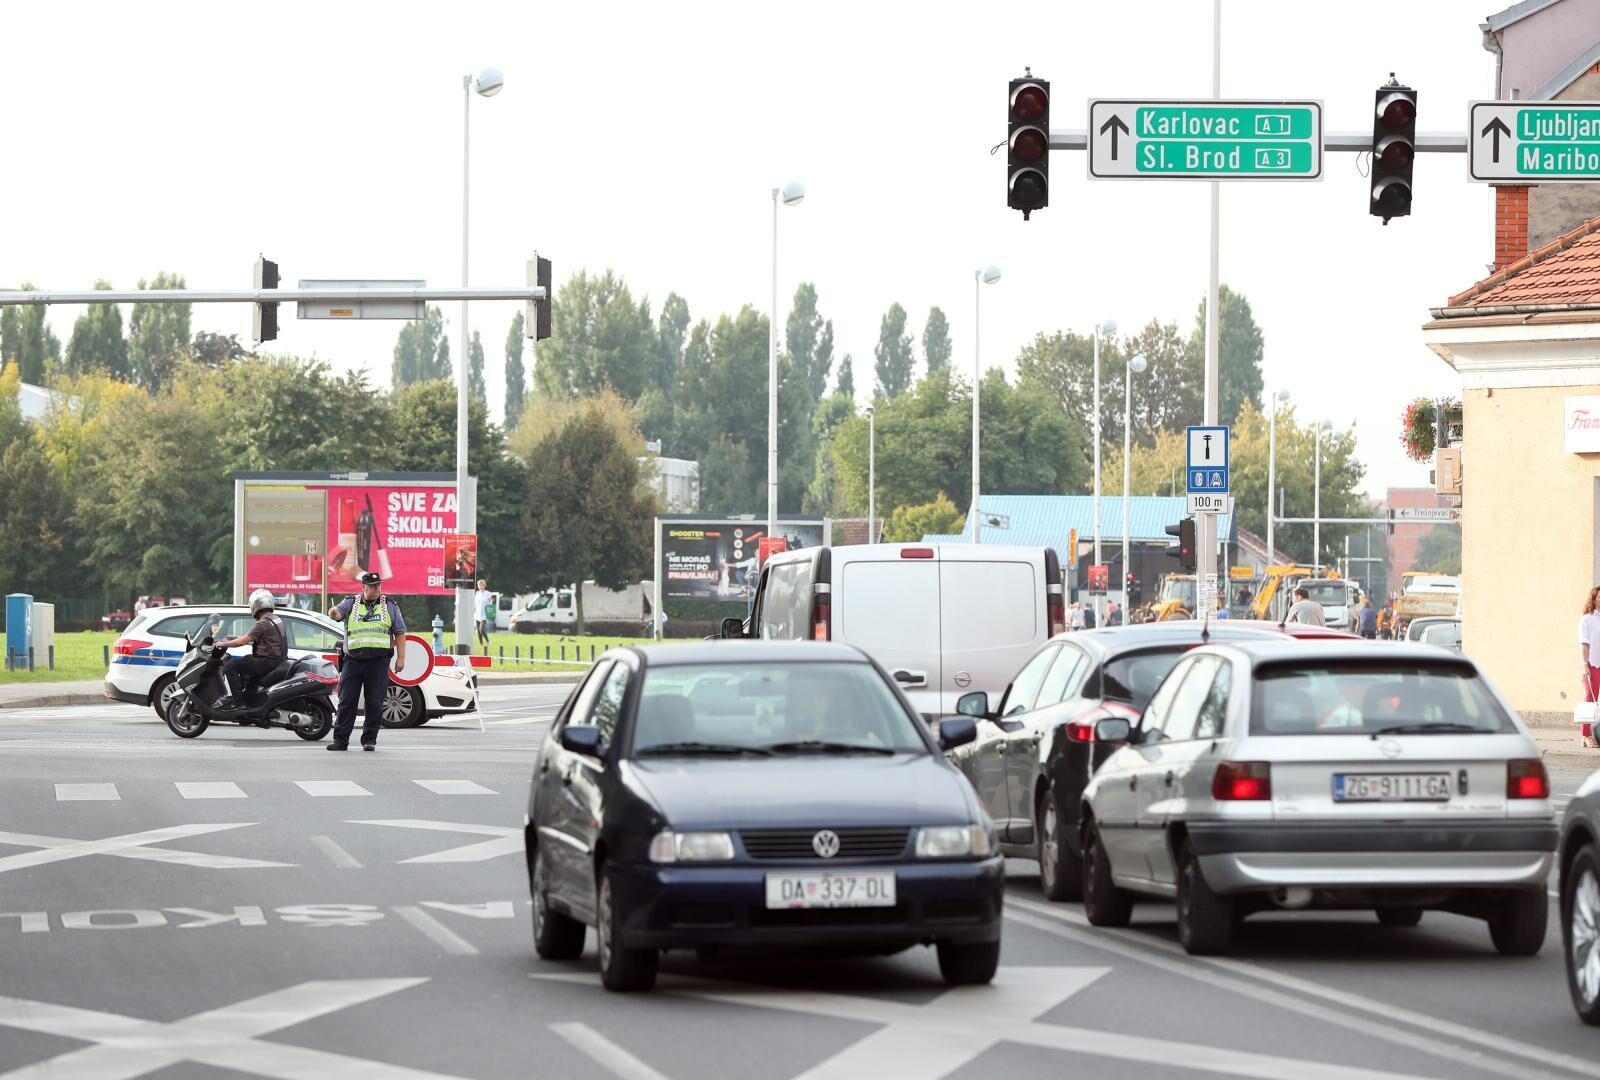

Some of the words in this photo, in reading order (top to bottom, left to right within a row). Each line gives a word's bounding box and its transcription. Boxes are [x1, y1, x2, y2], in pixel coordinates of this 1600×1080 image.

[1143, 111, 1240, 135] Karlovac
[1143, 144, 1174, 169] Sl.
[1185, 145, 1241, 169] Brod
[1523, 147, 1599, 171] Maribo
[387, 492, 426, 512] SVE
[431, 493, 457, 513] ZA
[1194, 496, 1211, 508] 100
[1214, 499, 1223, 508] m
[1347, 776, 1369, 797] ZG
[781, 878, 805, 900] DA
